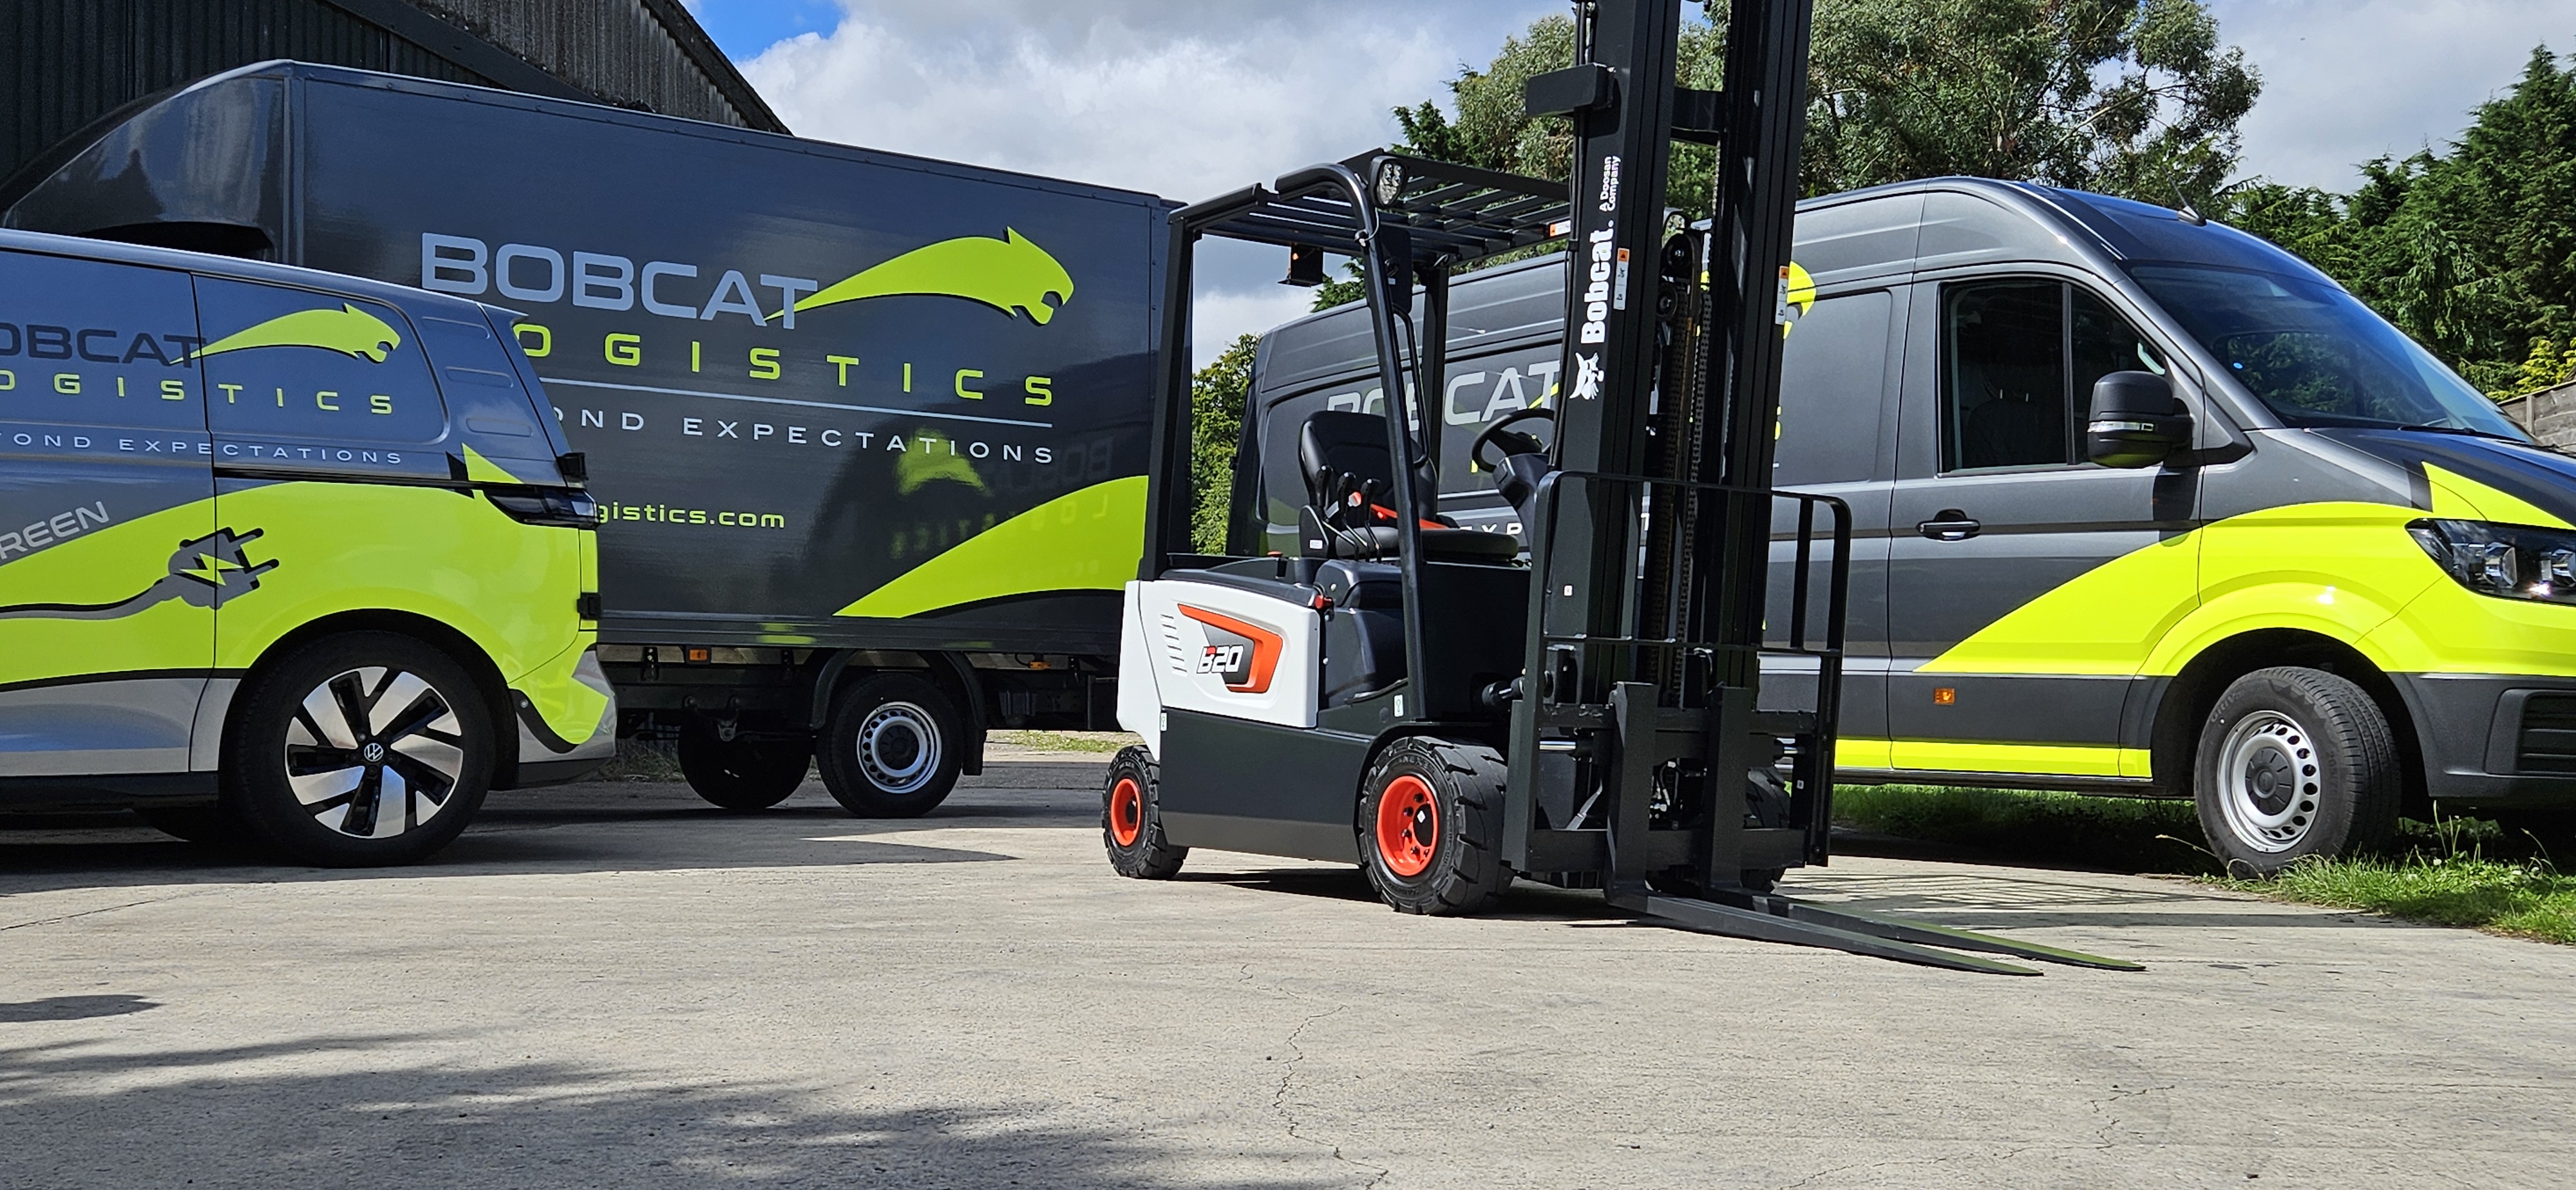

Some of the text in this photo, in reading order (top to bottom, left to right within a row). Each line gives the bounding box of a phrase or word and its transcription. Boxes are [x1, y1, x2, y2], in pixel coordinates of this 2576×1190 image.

[1599, 156, 1612, 212] A Doosan
[1607, 155, 1622, 212] Company
[422, 232, 818, 330] BOBCAT
[119, 439, 401, 464] EXPECTATIONS
[683, 417, 1053, 464] EXPECTATIONS
[1196, 645, 1244, 674] B20
